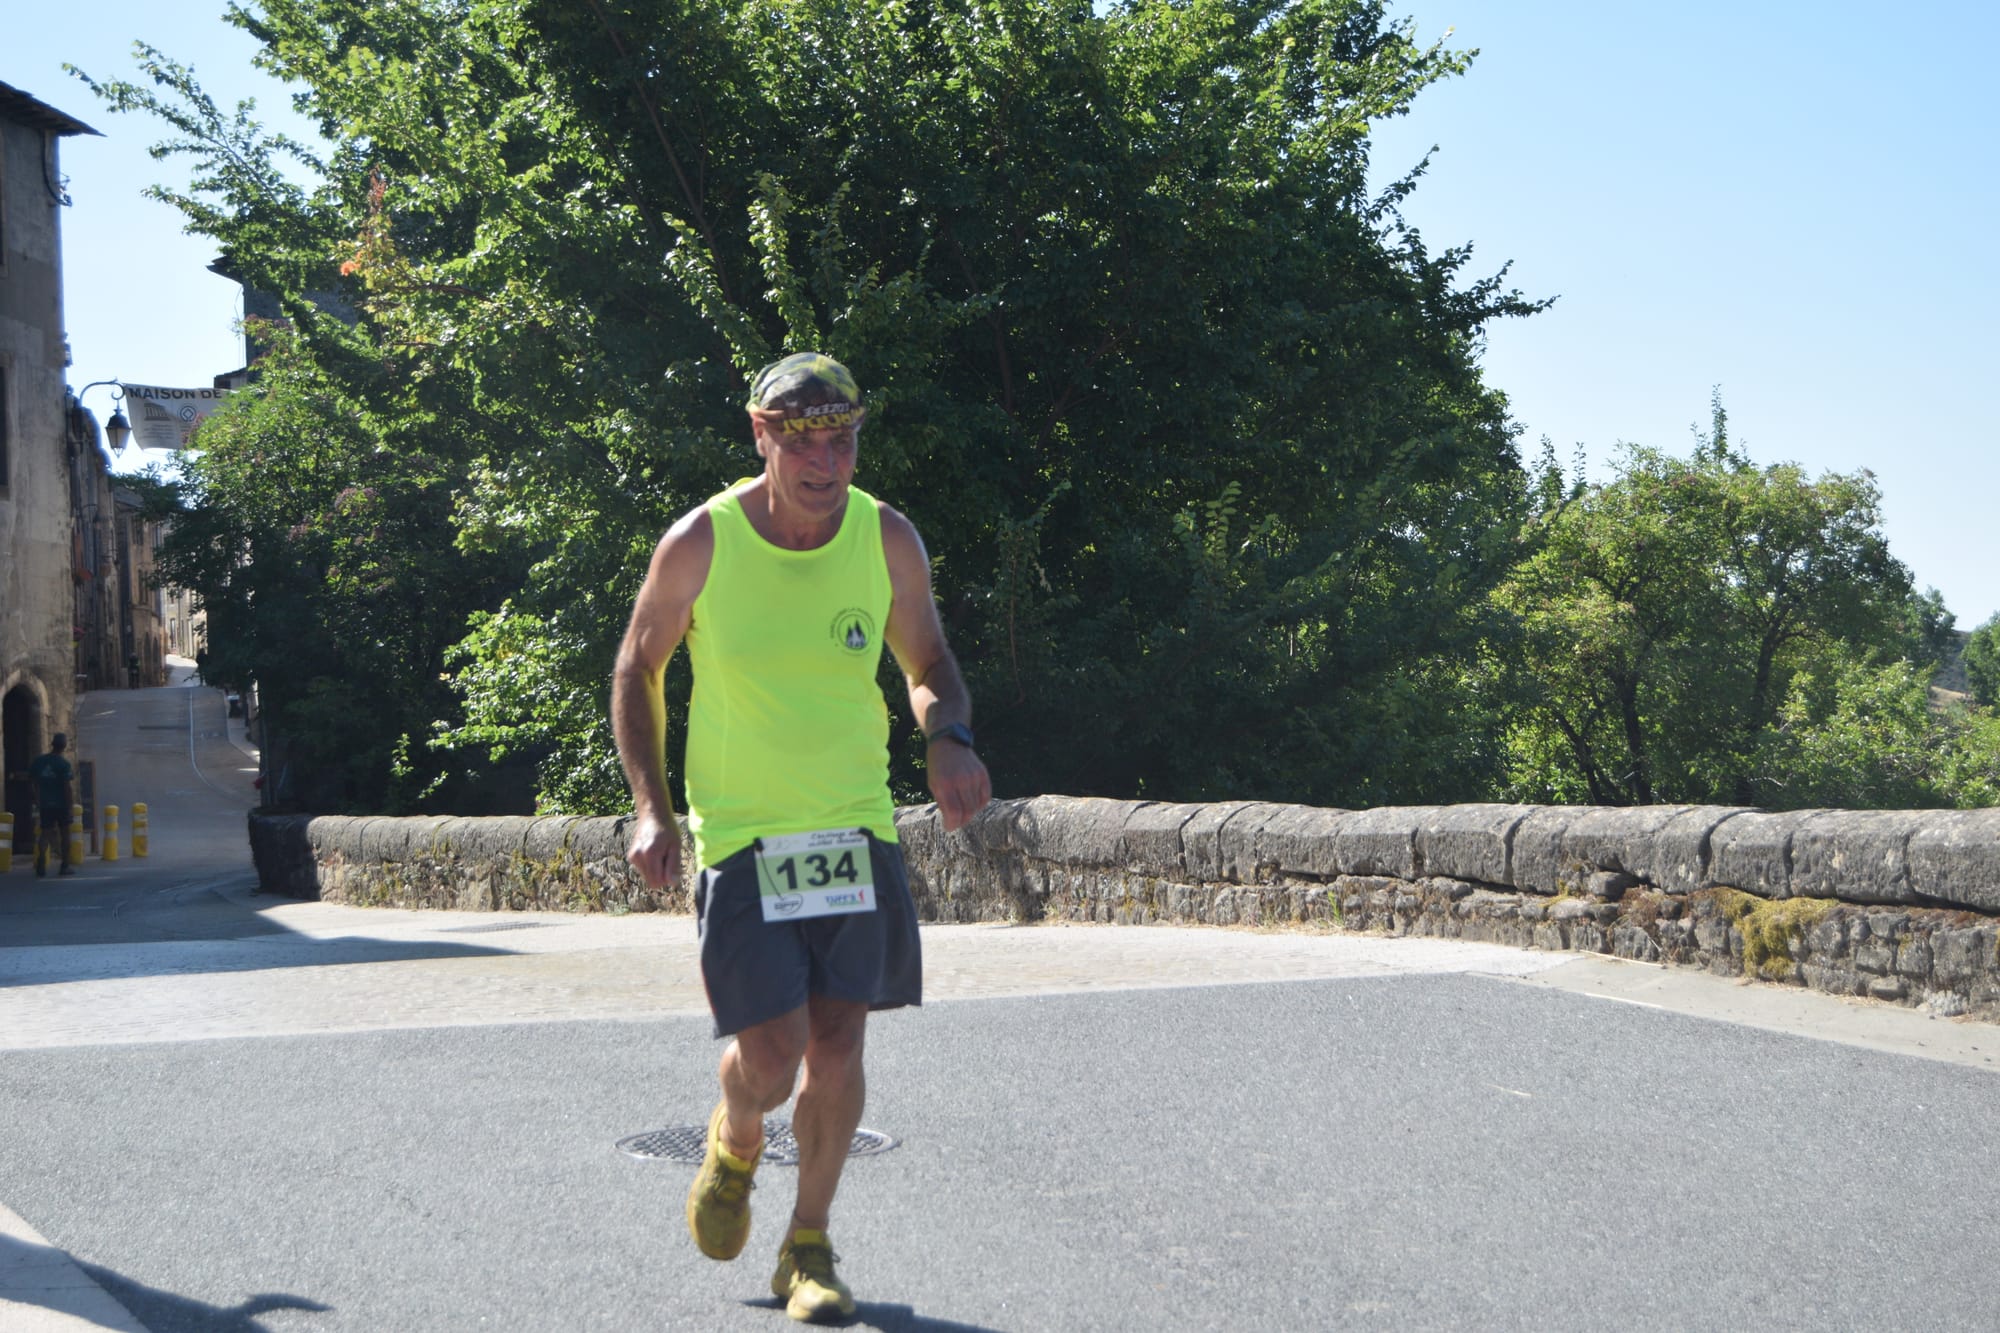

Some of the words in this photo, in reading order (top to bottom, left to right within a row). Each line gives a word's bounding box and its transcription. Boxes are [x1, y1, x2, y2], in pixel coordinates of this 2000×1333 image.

[129, 388, 196, 399] MAISON
[201, 389, 222, 399] DE
[776, 850, 859, 890] 134
